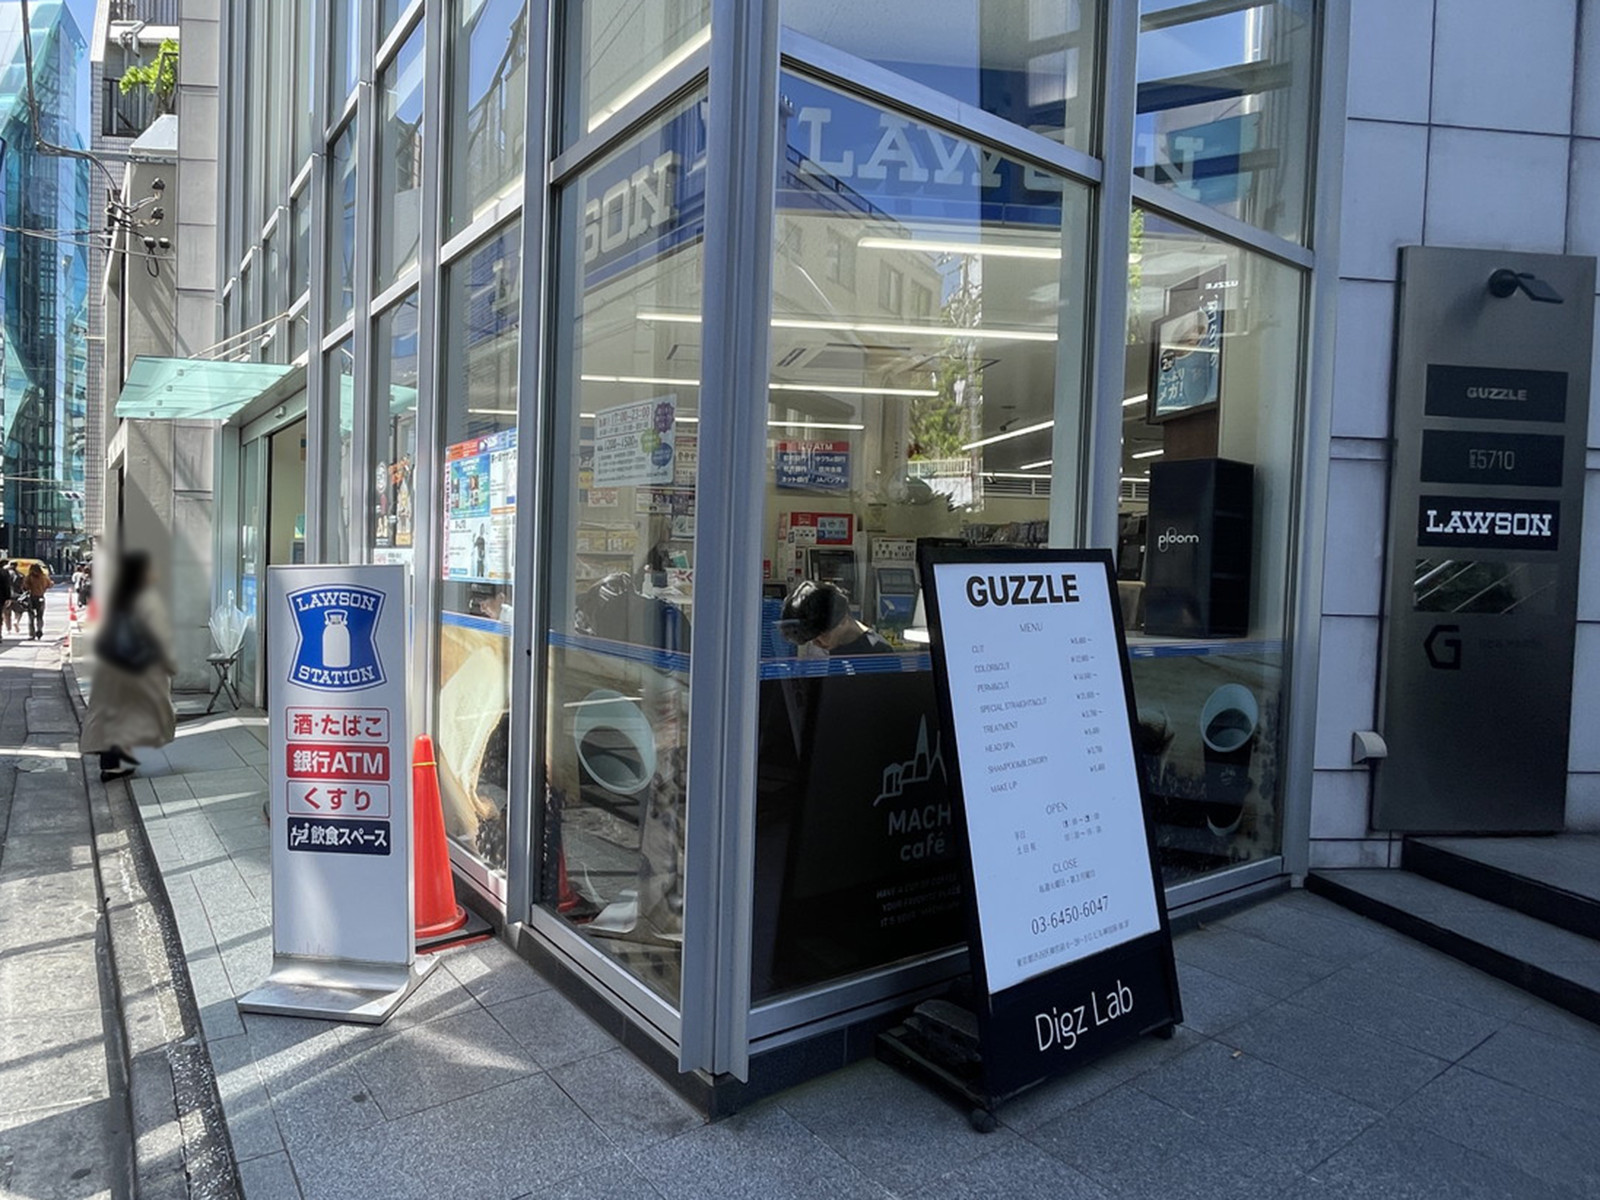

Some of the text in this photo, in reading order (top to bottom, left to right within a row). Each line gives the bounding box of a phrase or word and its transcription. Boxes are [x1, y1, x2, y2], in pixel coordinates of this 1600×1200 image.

[1467, 386, 1528, 401] GUZZLE
[1477, 449, 1515, 470] 5710
[1426, 510, 1552, 536] LAWSON
[966, 574, 1080, 607] GUZZLE
[296, 592, 377, 612] LAWSON
[1019, 623, 1044, 633] MENU
[298, 665, 377, 686] STATION
[293, 713, 383, 738] 酒・たばこ
[292, 751, 384, 775] 銀行ATM
[303, 787, 371, 811] くすり
[1045, 801, 1069, 815] OPEN
[310, 826, 388, 847] 飲食スペース
[900, 832, 945, 861] café
[1052, 857, 1079, 874] CLOSE
[1031, 895, 1110, 936] 03-6450-6047
[1035, 980, 1134, 1052] Digz Lab
